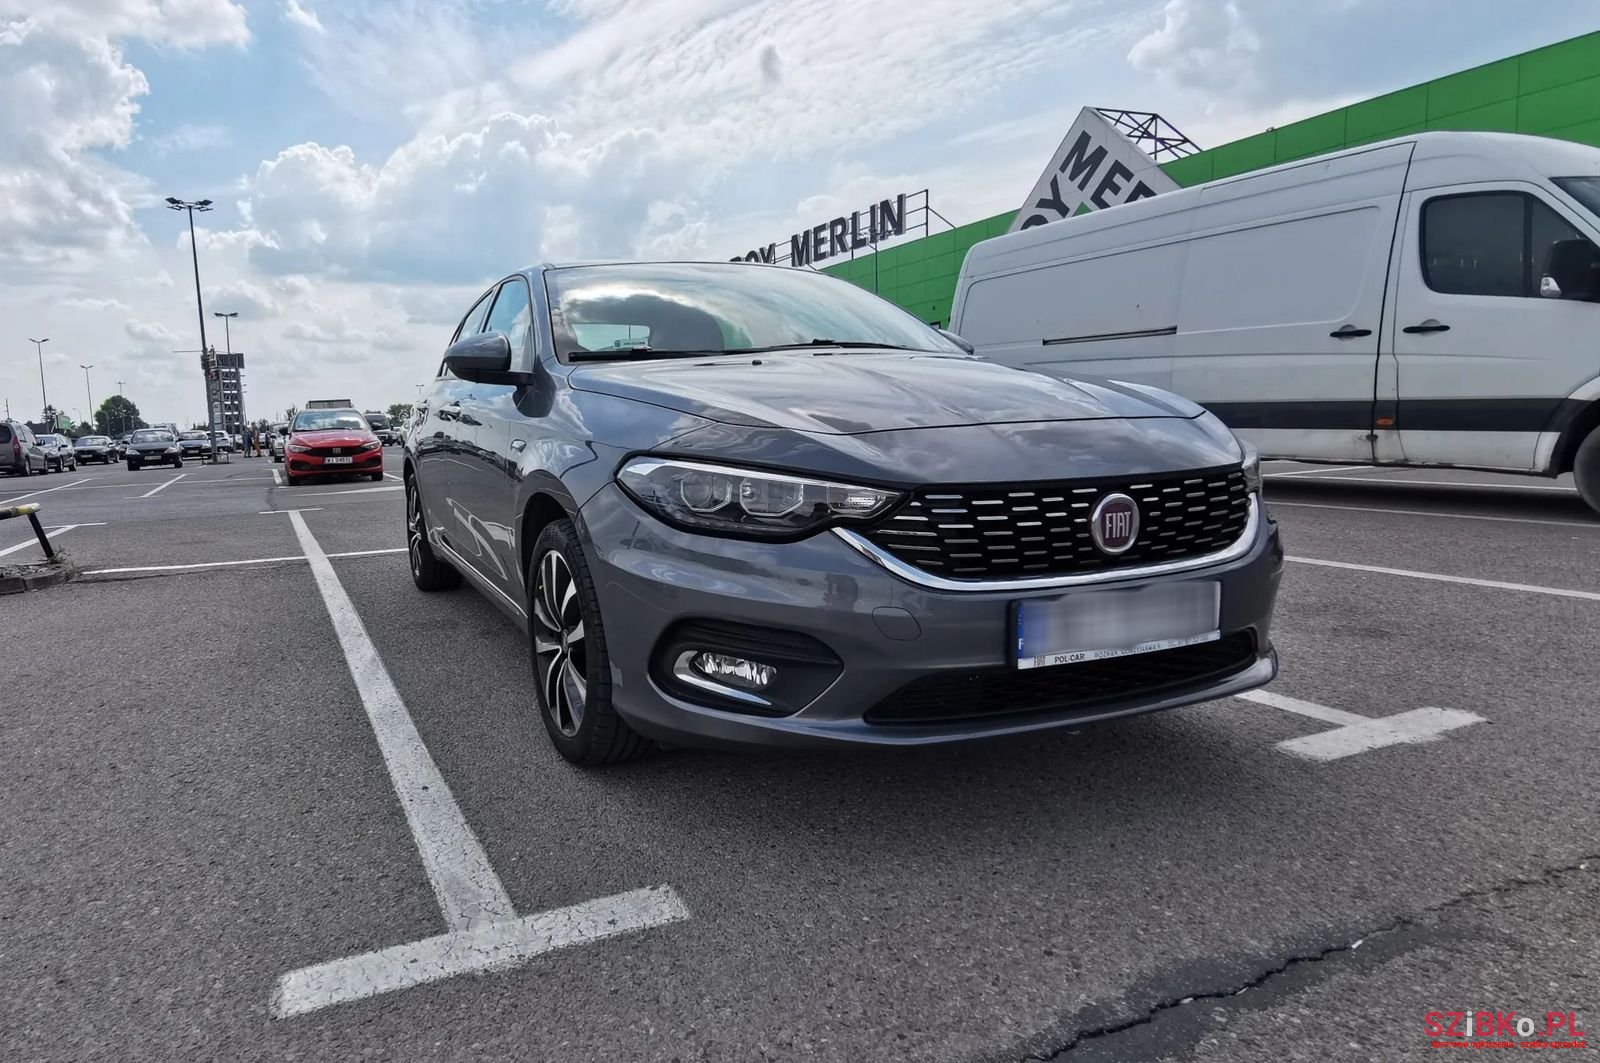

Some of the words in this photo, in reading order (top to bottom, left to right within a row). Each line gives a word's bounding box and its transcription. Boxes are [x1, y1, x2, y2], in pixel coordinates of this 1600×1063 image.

[791, 193, 907, 268] MERLIN
[1105, 511, 1132, 538] FIAT
[1054, 653, 1085, 664] POL-CAR
